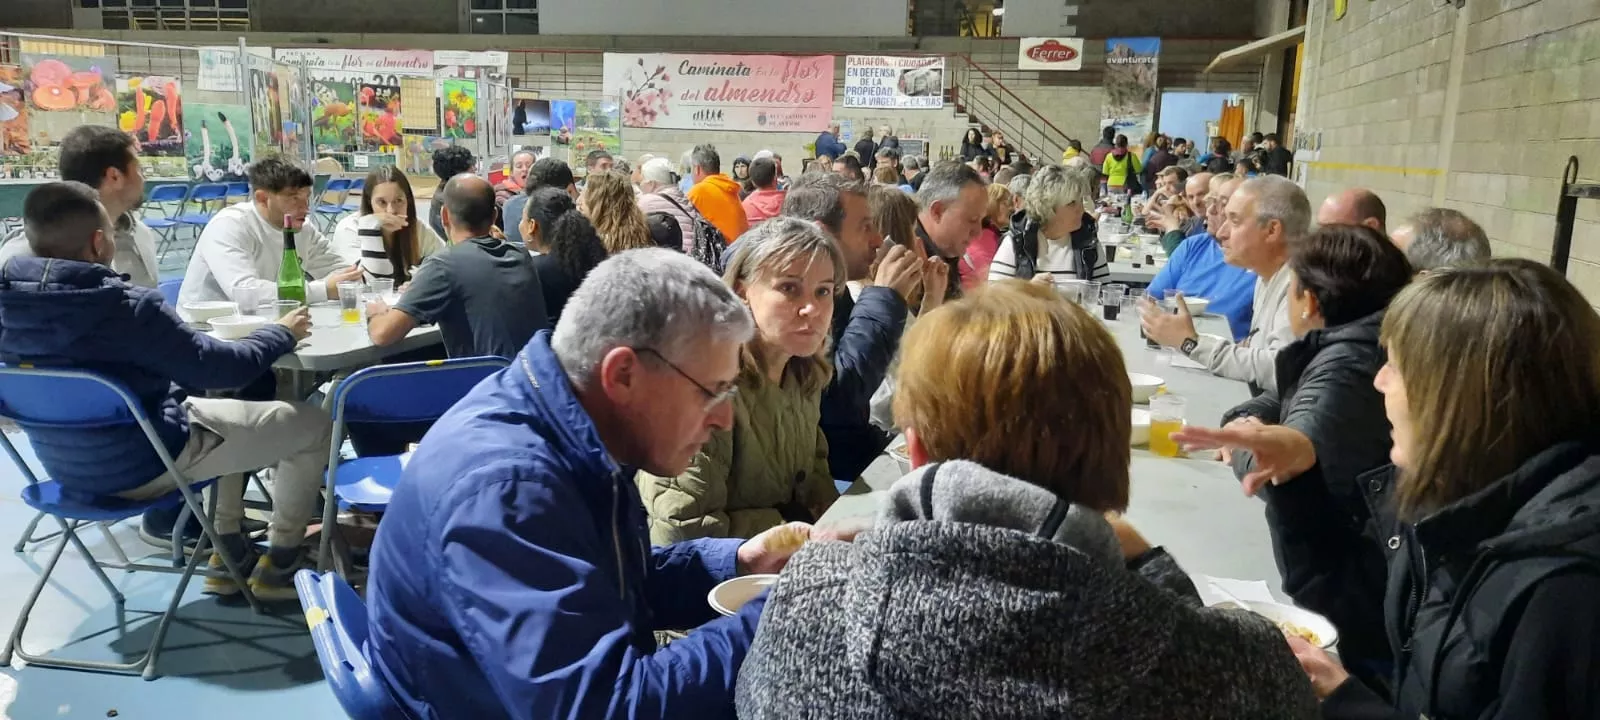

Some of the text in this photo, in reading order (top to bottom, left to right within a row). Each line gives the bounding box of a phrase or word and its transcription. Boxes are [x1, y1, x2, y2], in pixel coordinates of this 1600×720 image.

[1032, 47, 1072, 59] Ferrer
[678, 59, 751, 77] Caminata
[781, 59, 821, 83] flor
[847, 67, 895, 78] EN DEFENSA
[860, 78, 882, 86] DE LA
[680, 80, 817, 103] del almendro
[846, 86, 893, 97] PROPIEDAD
[845, 97, 855, 106] DE
[857, 97, 867, 106] LA
[868, 97, 897, 107] VIRGEN
